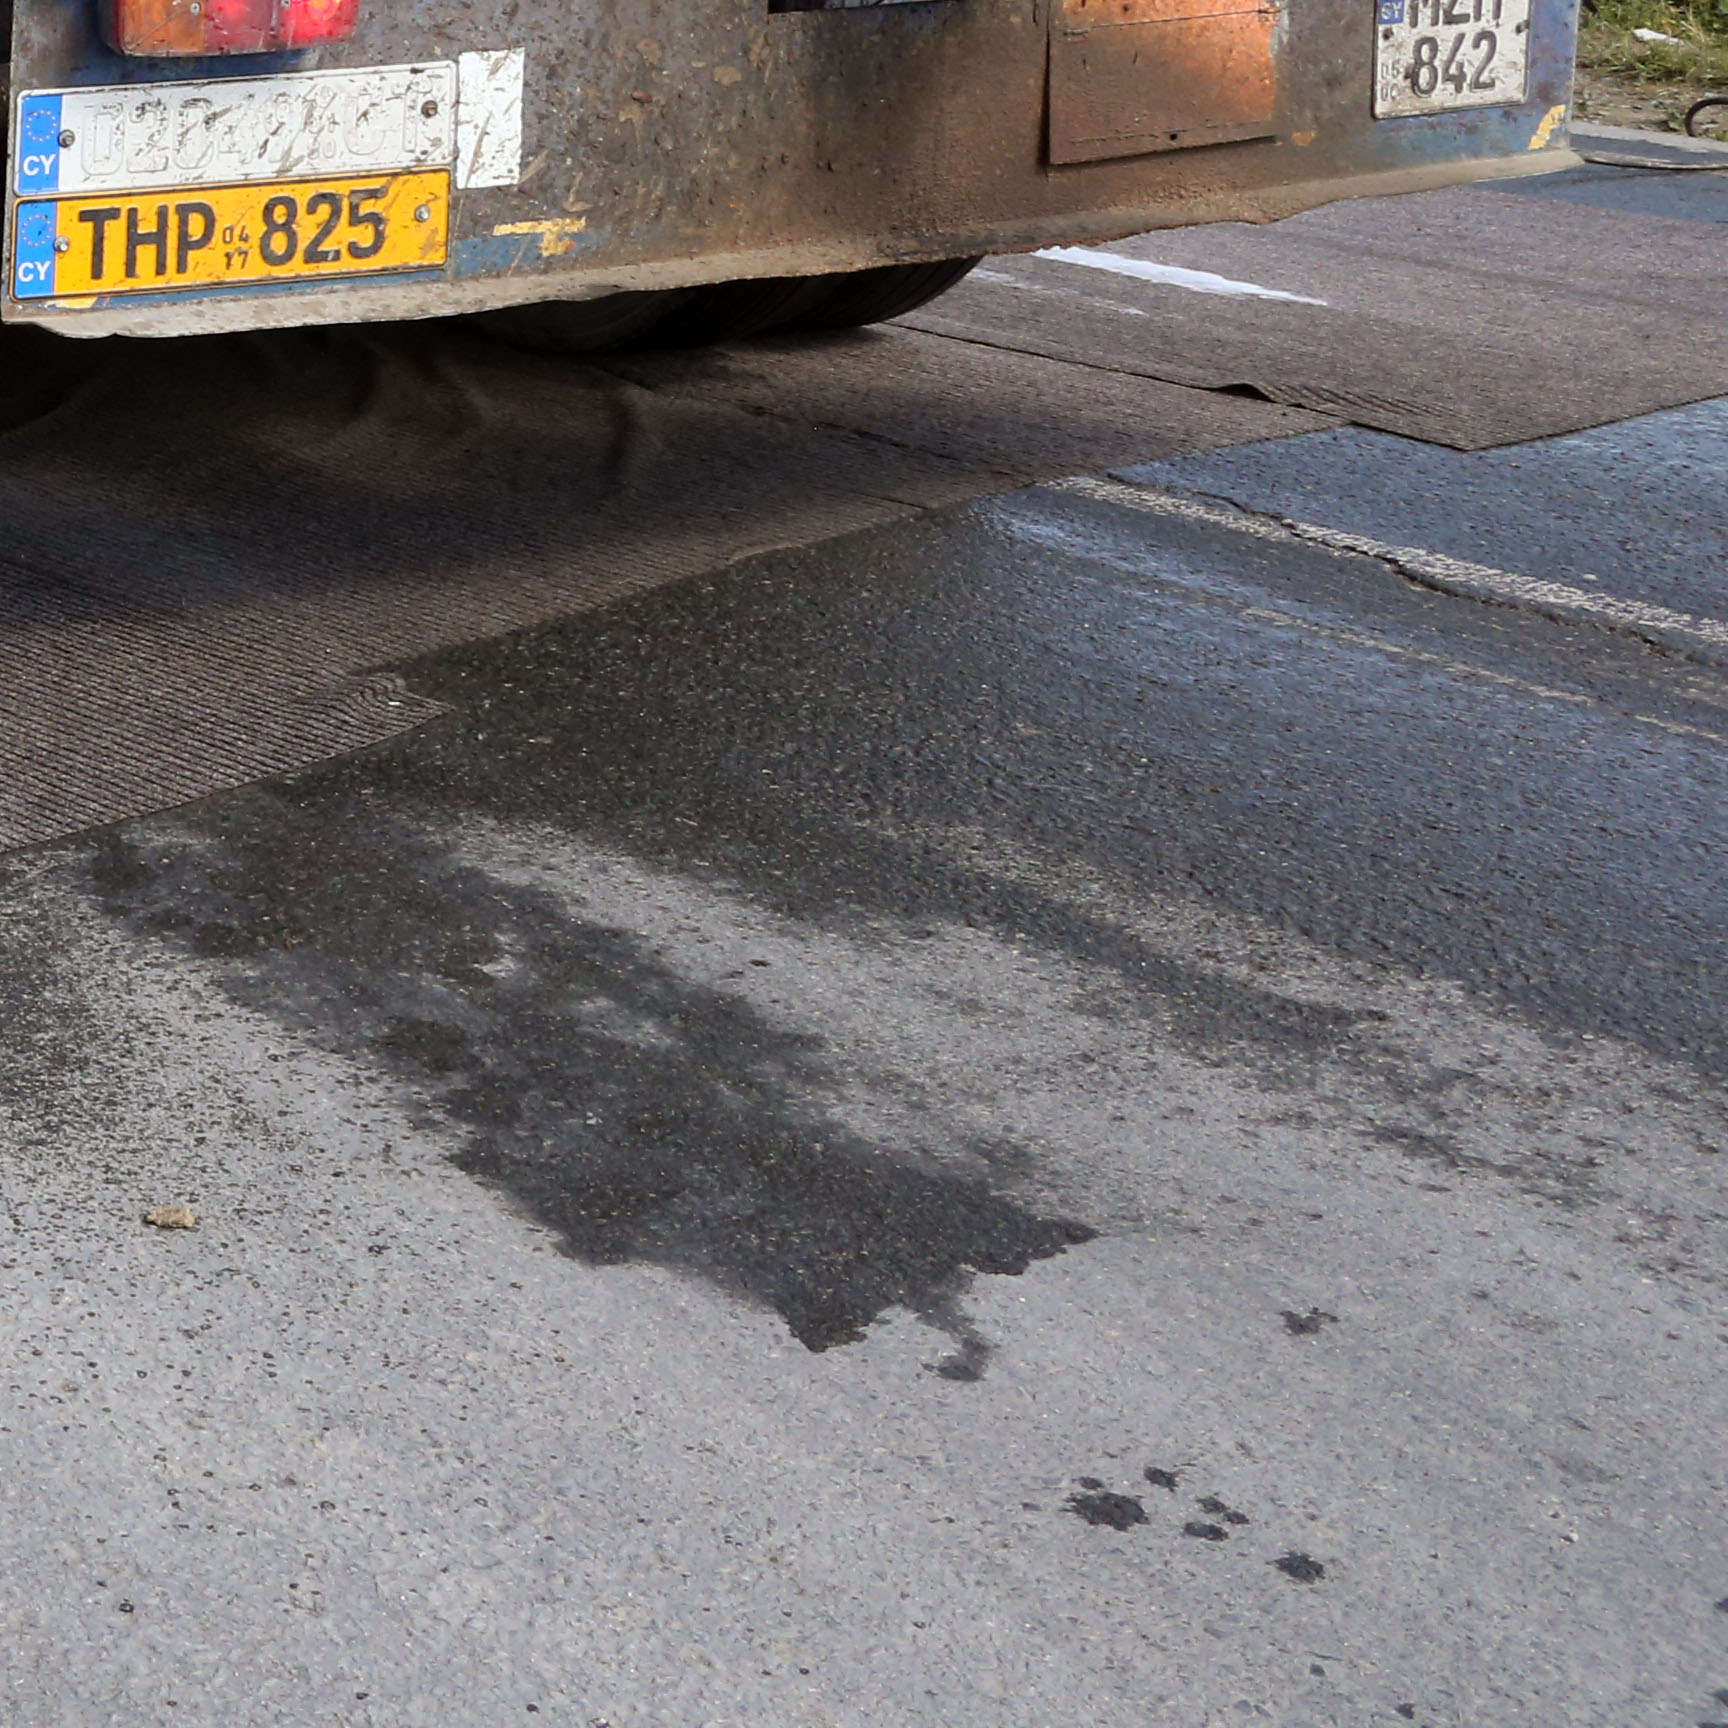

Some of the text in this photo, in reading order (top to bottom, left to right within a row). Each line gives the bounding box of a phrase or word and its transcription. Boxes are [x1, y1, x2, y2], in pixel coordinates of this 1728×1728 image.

[1410, 30, 1498, 98] 842
[23, 153, 56, 177] CY
[78, 184, 390, 281] THP 825
[18, 261, 51, 284] CY
